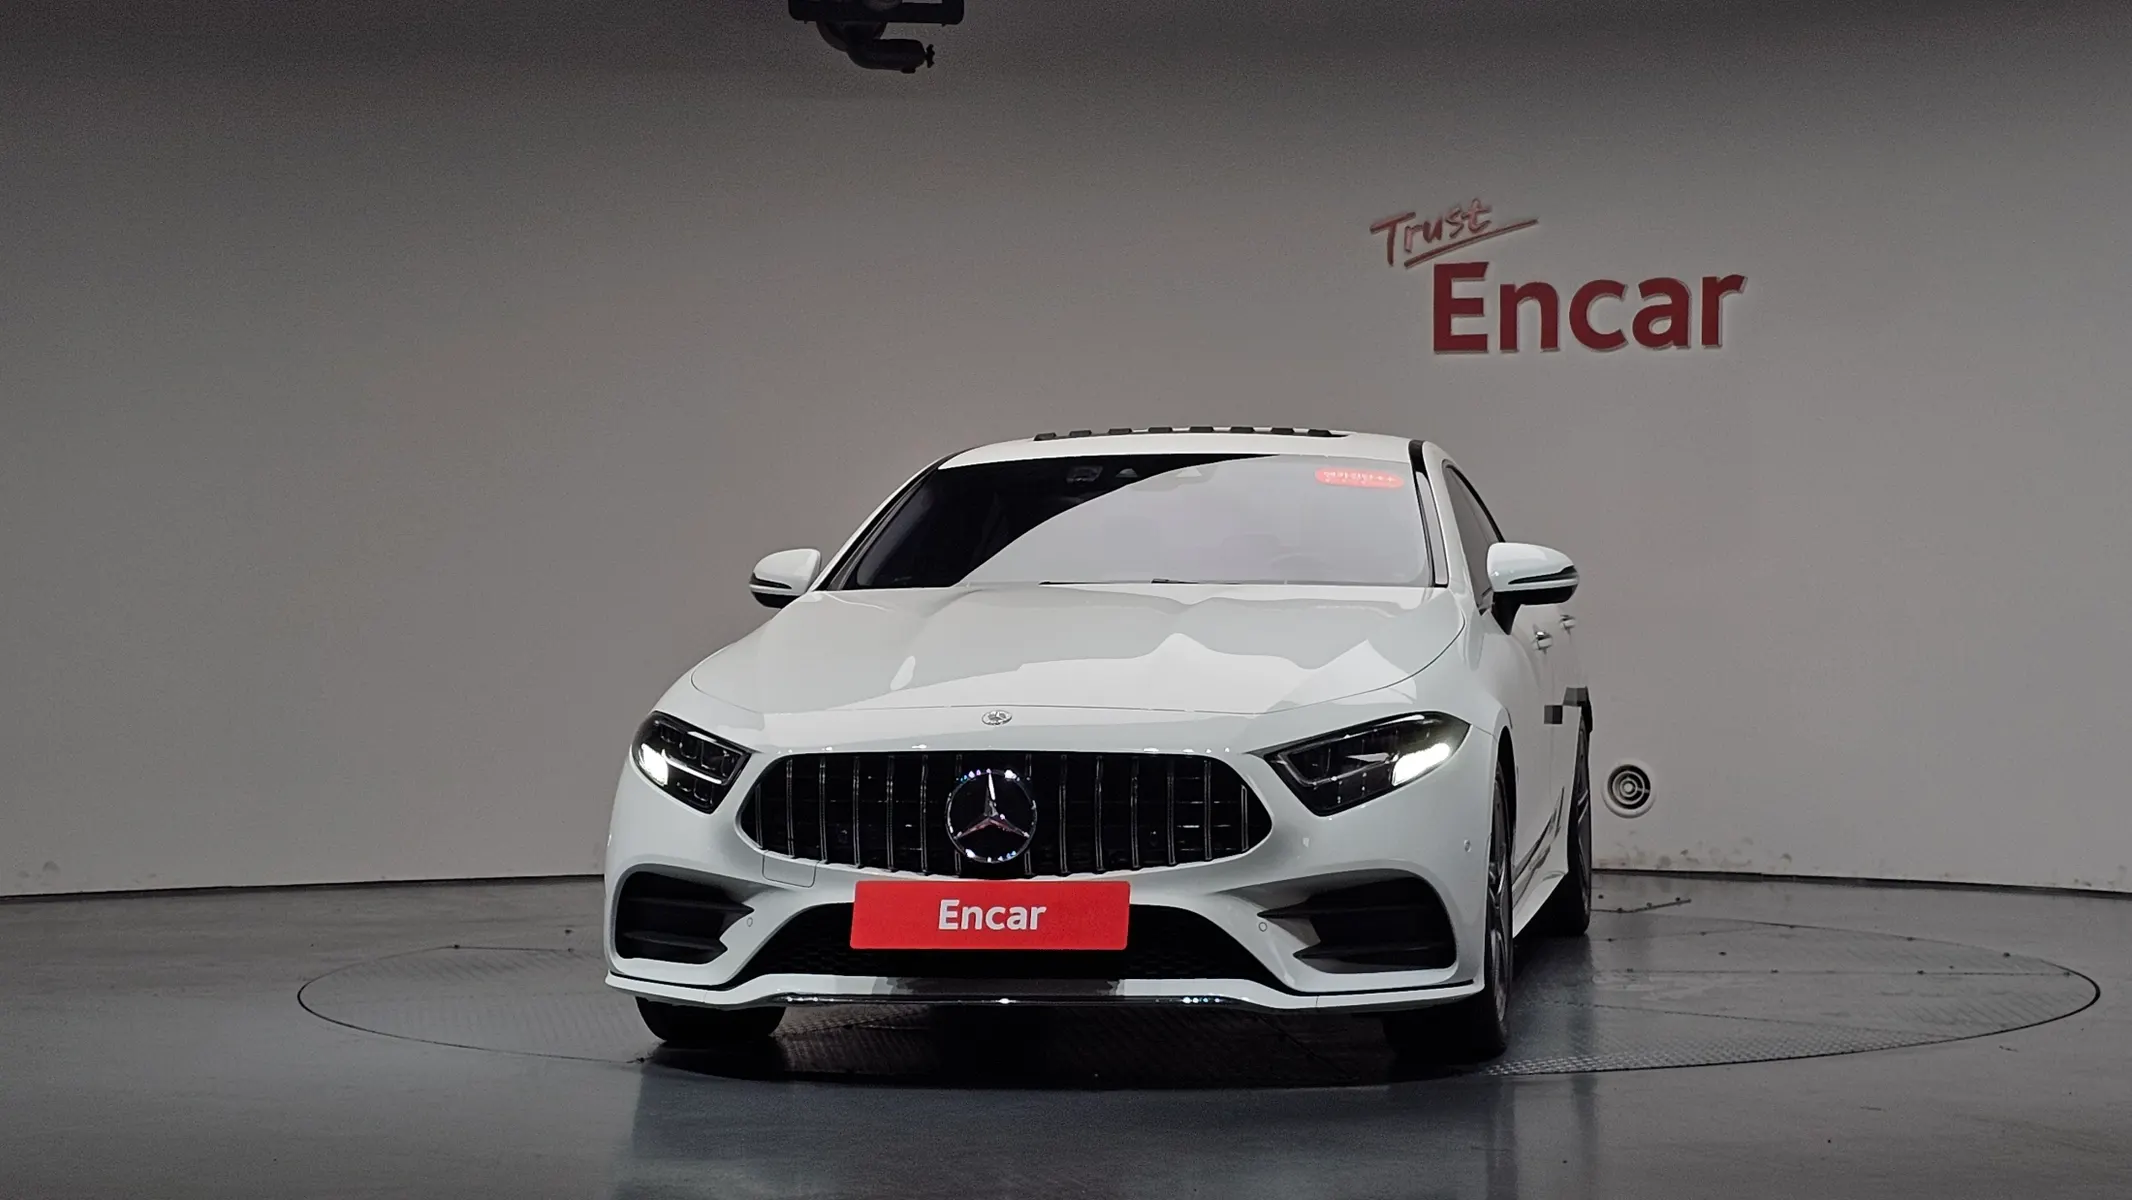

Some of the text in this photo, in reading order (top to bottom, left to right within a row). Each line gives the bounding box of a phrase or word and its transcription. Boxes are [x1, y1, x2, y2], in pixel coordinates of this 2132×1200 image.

[1370, 198, 1492, 267] Trust
[1433, 261, 1749, 354] Encar
[938, 899, 1047, 931] Encar
